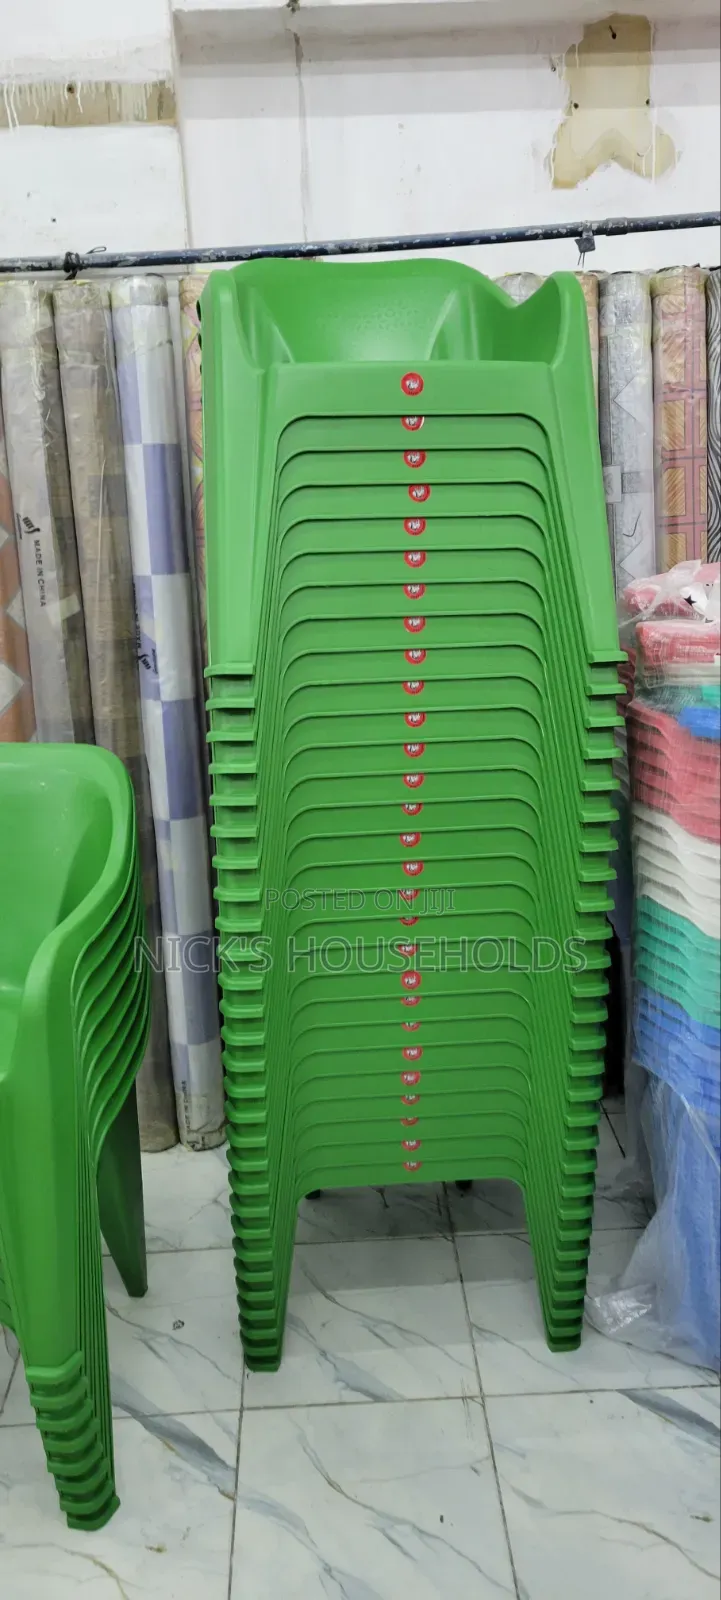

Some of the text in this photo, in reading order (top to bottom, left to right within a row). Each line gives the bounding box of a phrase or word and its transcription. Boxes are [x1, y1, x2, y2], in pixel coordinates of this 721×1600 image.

[34, 540, 46, 607] MADE IN CHINA
